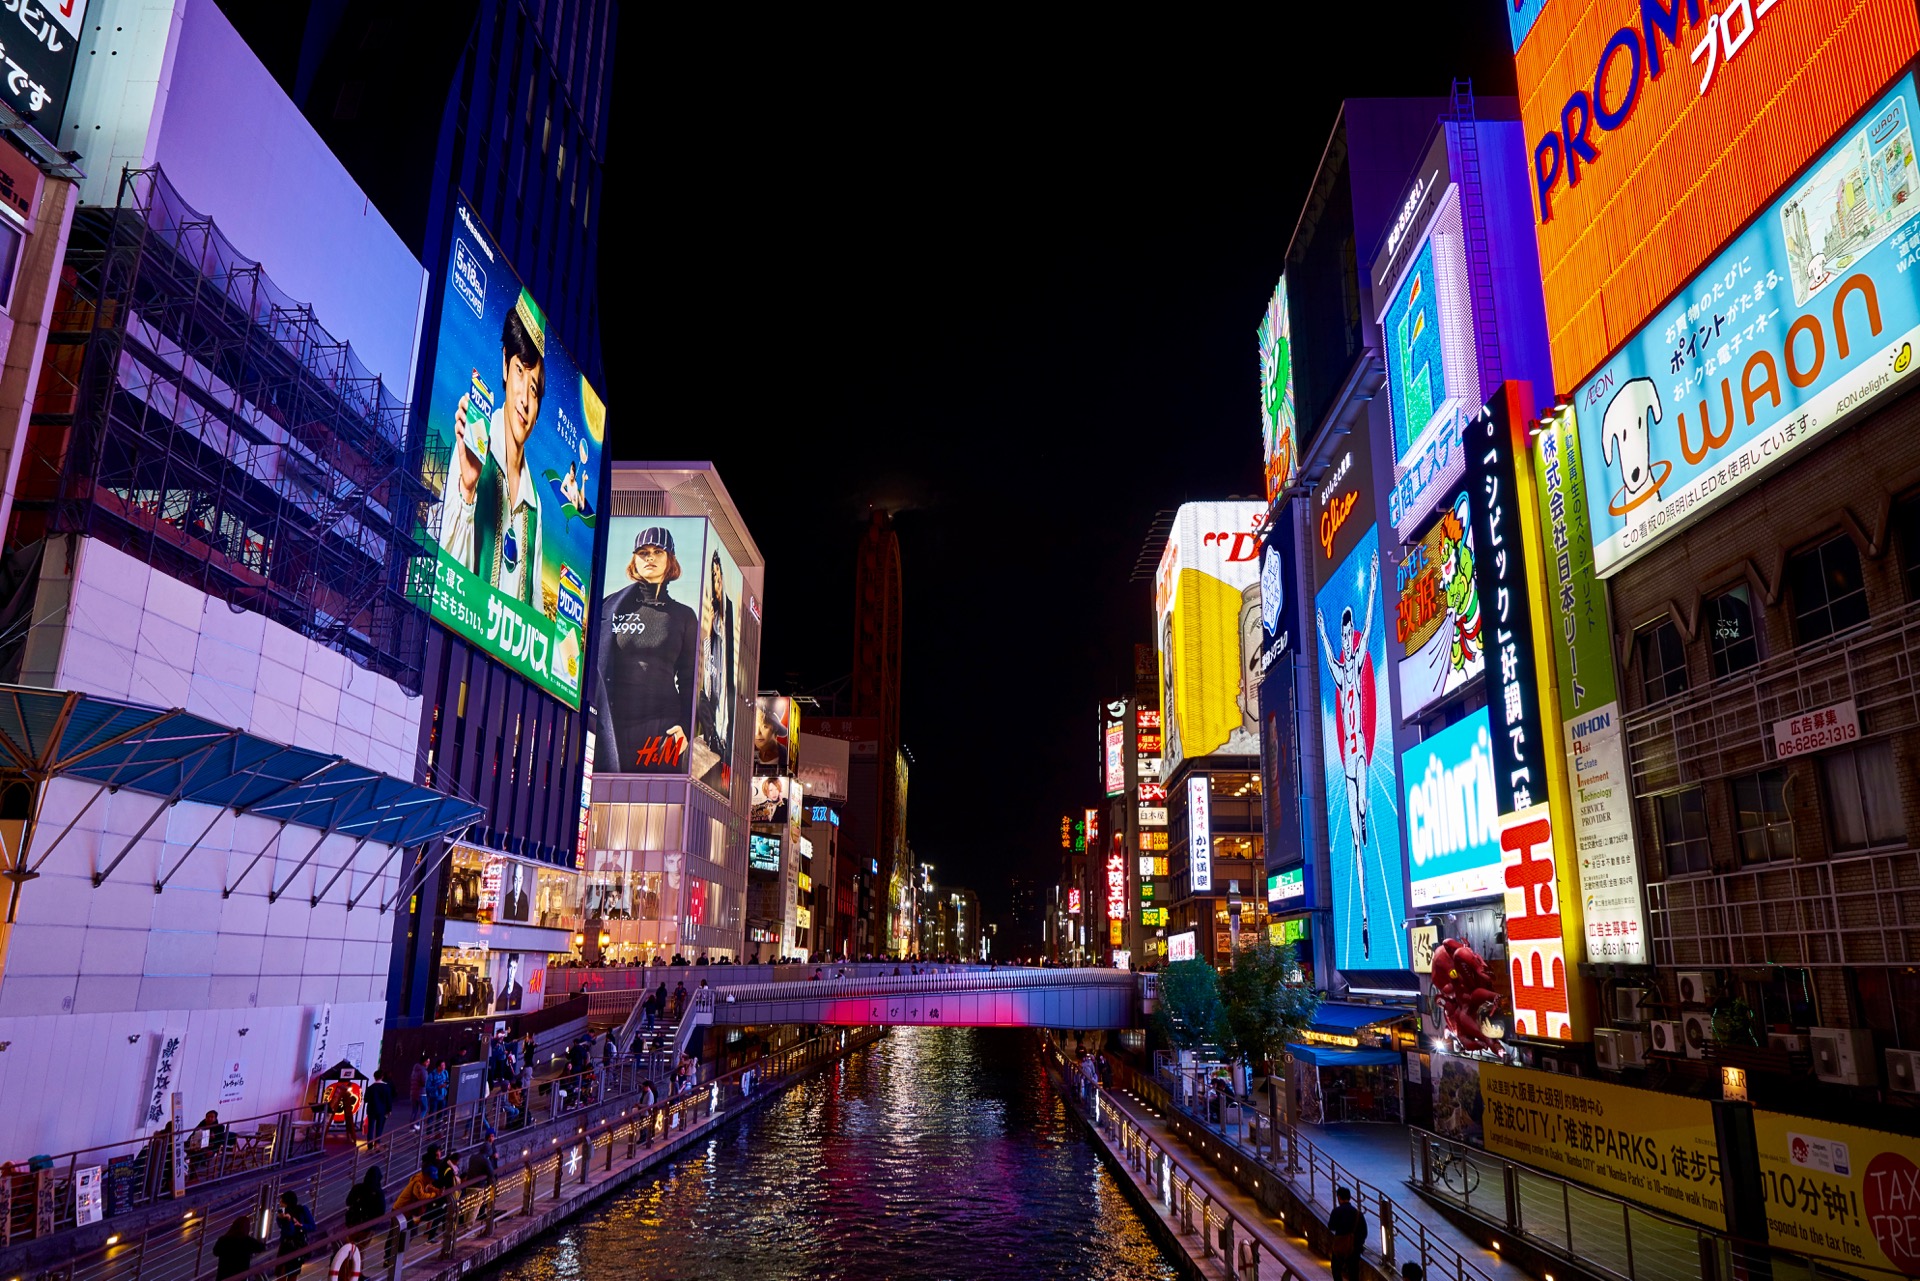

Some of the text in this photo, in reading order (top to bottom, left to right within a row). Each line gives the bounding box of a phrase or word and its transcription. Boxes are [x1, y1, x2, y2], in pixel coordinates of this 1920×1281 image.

[0, 42, 51, 112] です
[1664, 255, 1752, 345] お買物のたびに
[1669, 267, 1784, 375] ポイントがたまる、
[1672, 306, 1780, 403] おトクな電子マネー
[1677, 273, 1883, 465] WAON
[1858, 371, 1890, 400] delight
[1621, 413, 1818, 549] この看板の照明はLEDを使用しています。
[1562, 417, 1595, 634] 不動産再生のスペシャリスト
[1541, 433, 1584, 709] 株式会社日本リート
[611, 613, 641, 622] トップス
[1395, 569, 1437, 643] 改源
[487, 593, 549, 678] サロンパス
[611, 622, 646, 635] ¥999
[1571, 712, 1610, 740] NIHON
[1789, 708, 1838, 736] 広告募集
[635, 735, 685, 767] H&M
[1573, 740, 1591, 757] Real
[1778, 723, 1857, 756] 06-6262-1313
[1575, 756, 1598, 772] Estate
[1577, 770, 1610, 789] Investment
[1578, 787, 1612, 804] Technology
[1580, 802, 1605, 816] SERVICE
[1581, 812, 1612, 827] PROVIDER
[1588, 919, 1638, 938] 広告主募集中
[1590, 941, 1641, 957] 06-6281-1717
[1722, 1069, 1747, 1089] BAR
[1703, 1193, 1718, 1211] from
[1799, 1223, 1808, 1238] to
[1810, 1226, 1824, 1246] the
[1826, 1233, 1841, 1251] tax
[1872, 1214, 1920, 1258] FRE
